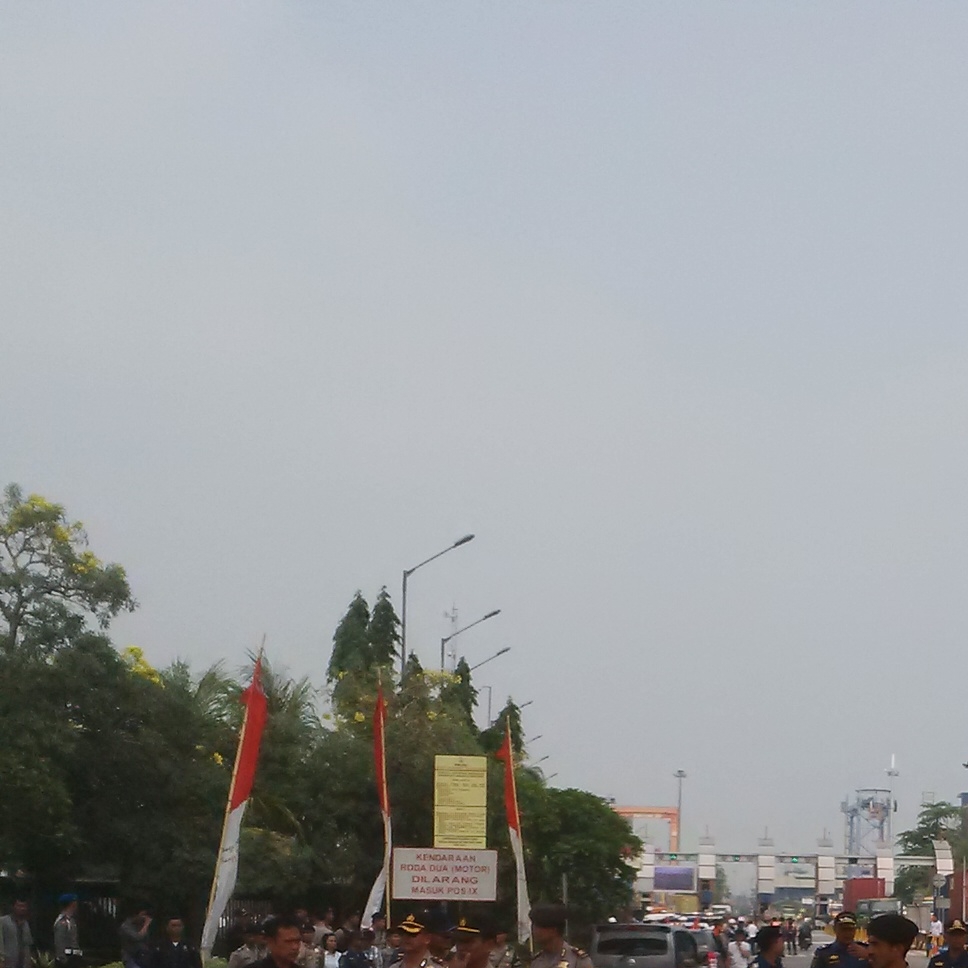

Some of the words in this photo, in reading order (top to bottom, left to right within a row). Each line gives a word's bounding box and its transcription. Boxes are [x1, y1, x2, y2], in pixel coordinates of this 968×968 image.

[416, 853, 476, 863] KENDARAAN
[429, 864, 448, 872] DUA
[451, 865, 490, 874] (MOTOR)
[411, 875, 479, 885] DILARANG
[411, 886, 444, 895] MASUK
[447, 887, 466, 895] POS
[469, 887, 478, 895] IX
